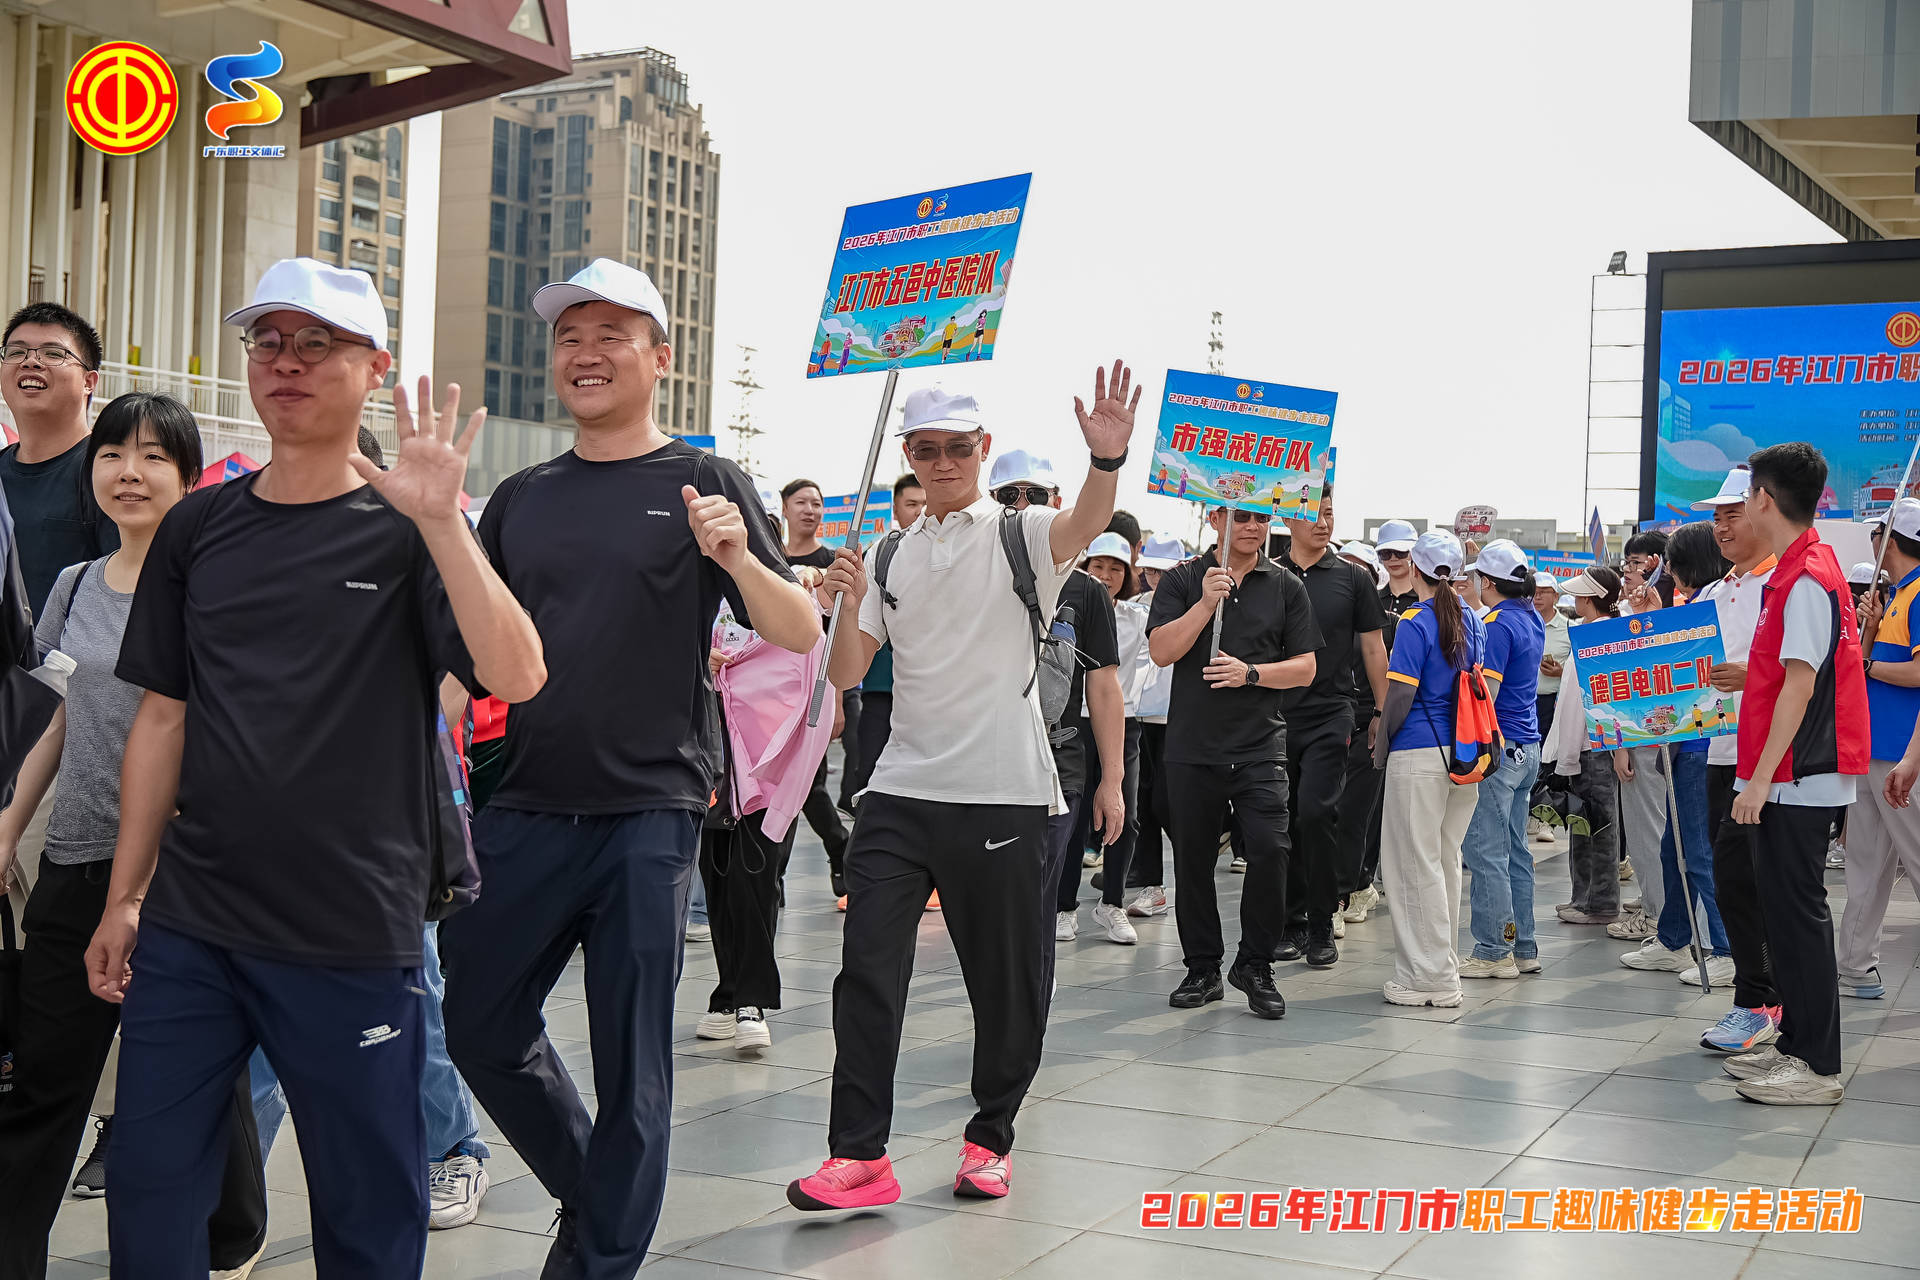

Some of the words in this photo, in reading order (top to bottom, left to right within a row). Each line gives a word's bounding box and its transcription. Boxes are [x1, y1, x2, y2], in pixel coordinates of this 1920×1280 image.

[842, 207, 1020, 250] 2026年江门市职工趣味健步走活动
[834, 250, 1001, 314] 江门市五邑中医院队
[1168, 393, 1331, 426] 2026年江门市职工趣味健步走活动
[1170, 423, 1314, 473] 市强戒所队
[1578, 625, 1717, 659] 2026年江门市职工趣味健步走活动
[1589, 655, 1713, 705] 德昌电机二队
